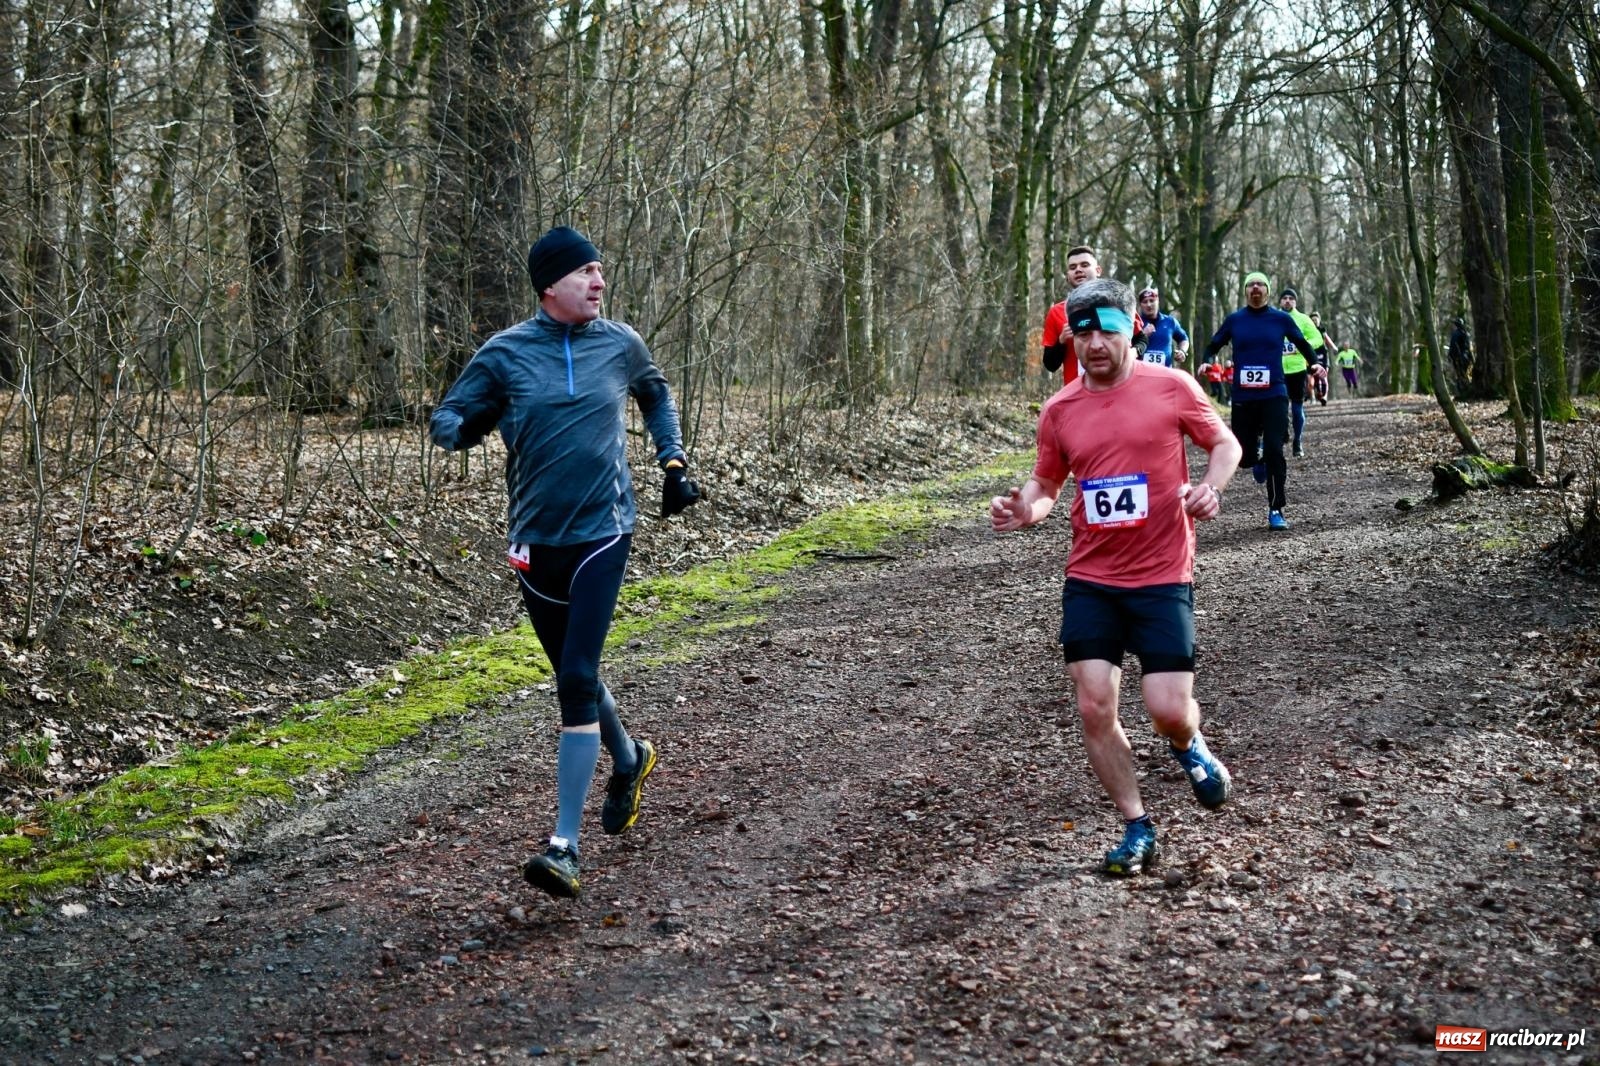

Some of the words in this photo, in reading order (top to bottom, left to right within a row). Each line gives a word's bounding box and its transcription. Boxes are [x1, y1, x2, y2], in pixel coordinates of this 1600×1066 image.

[1149, 354, 1161, 363] 35
[1246, 371, 1263, 382] 92
[1095, 488, 1136, 517] 64
